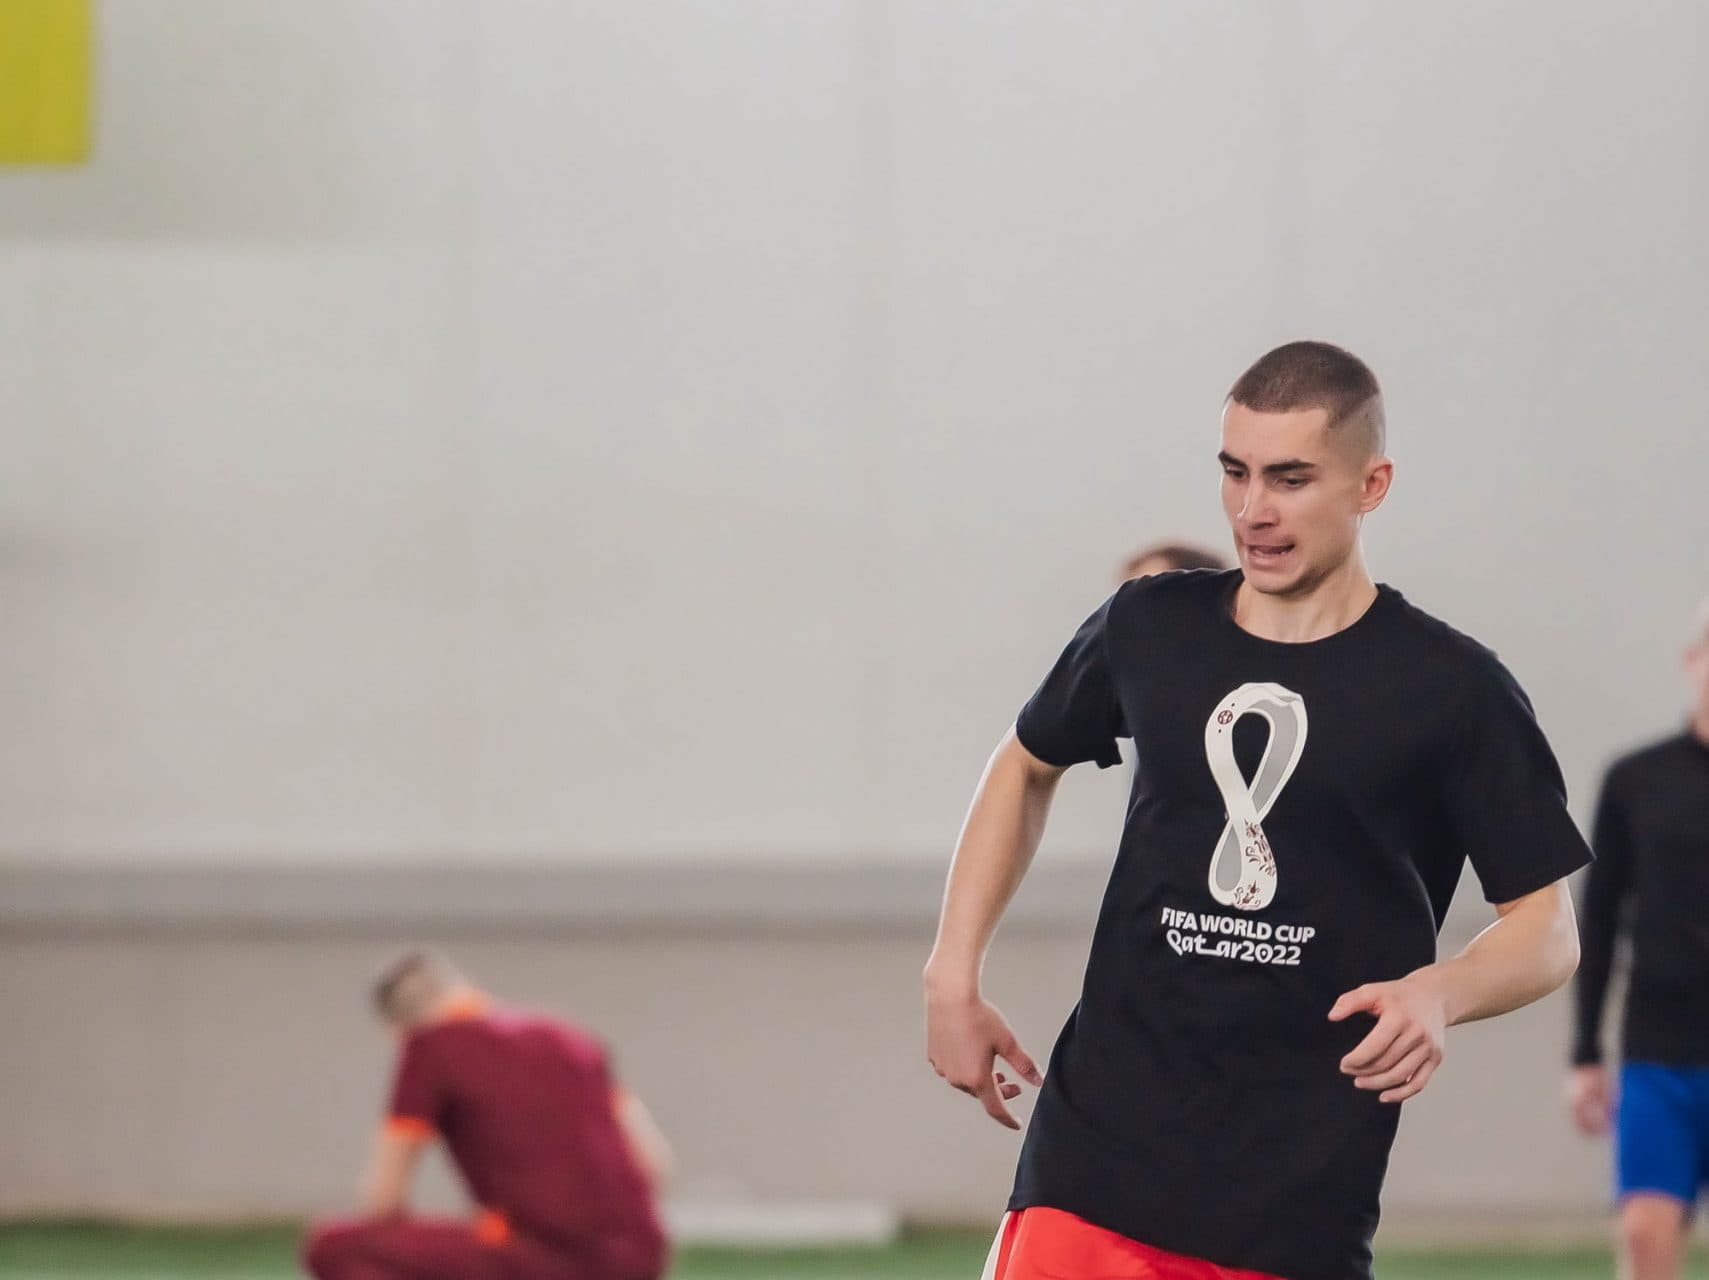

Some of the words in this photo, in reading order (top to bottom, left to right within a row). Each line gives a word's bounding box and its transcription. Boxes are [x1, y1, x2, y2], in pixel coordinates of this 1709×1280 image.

[1161, 906, 1198, 931] FIFA
[1200, 913, 1273, 940] WORLD
[1275, 925, 1316, 944] CUP
